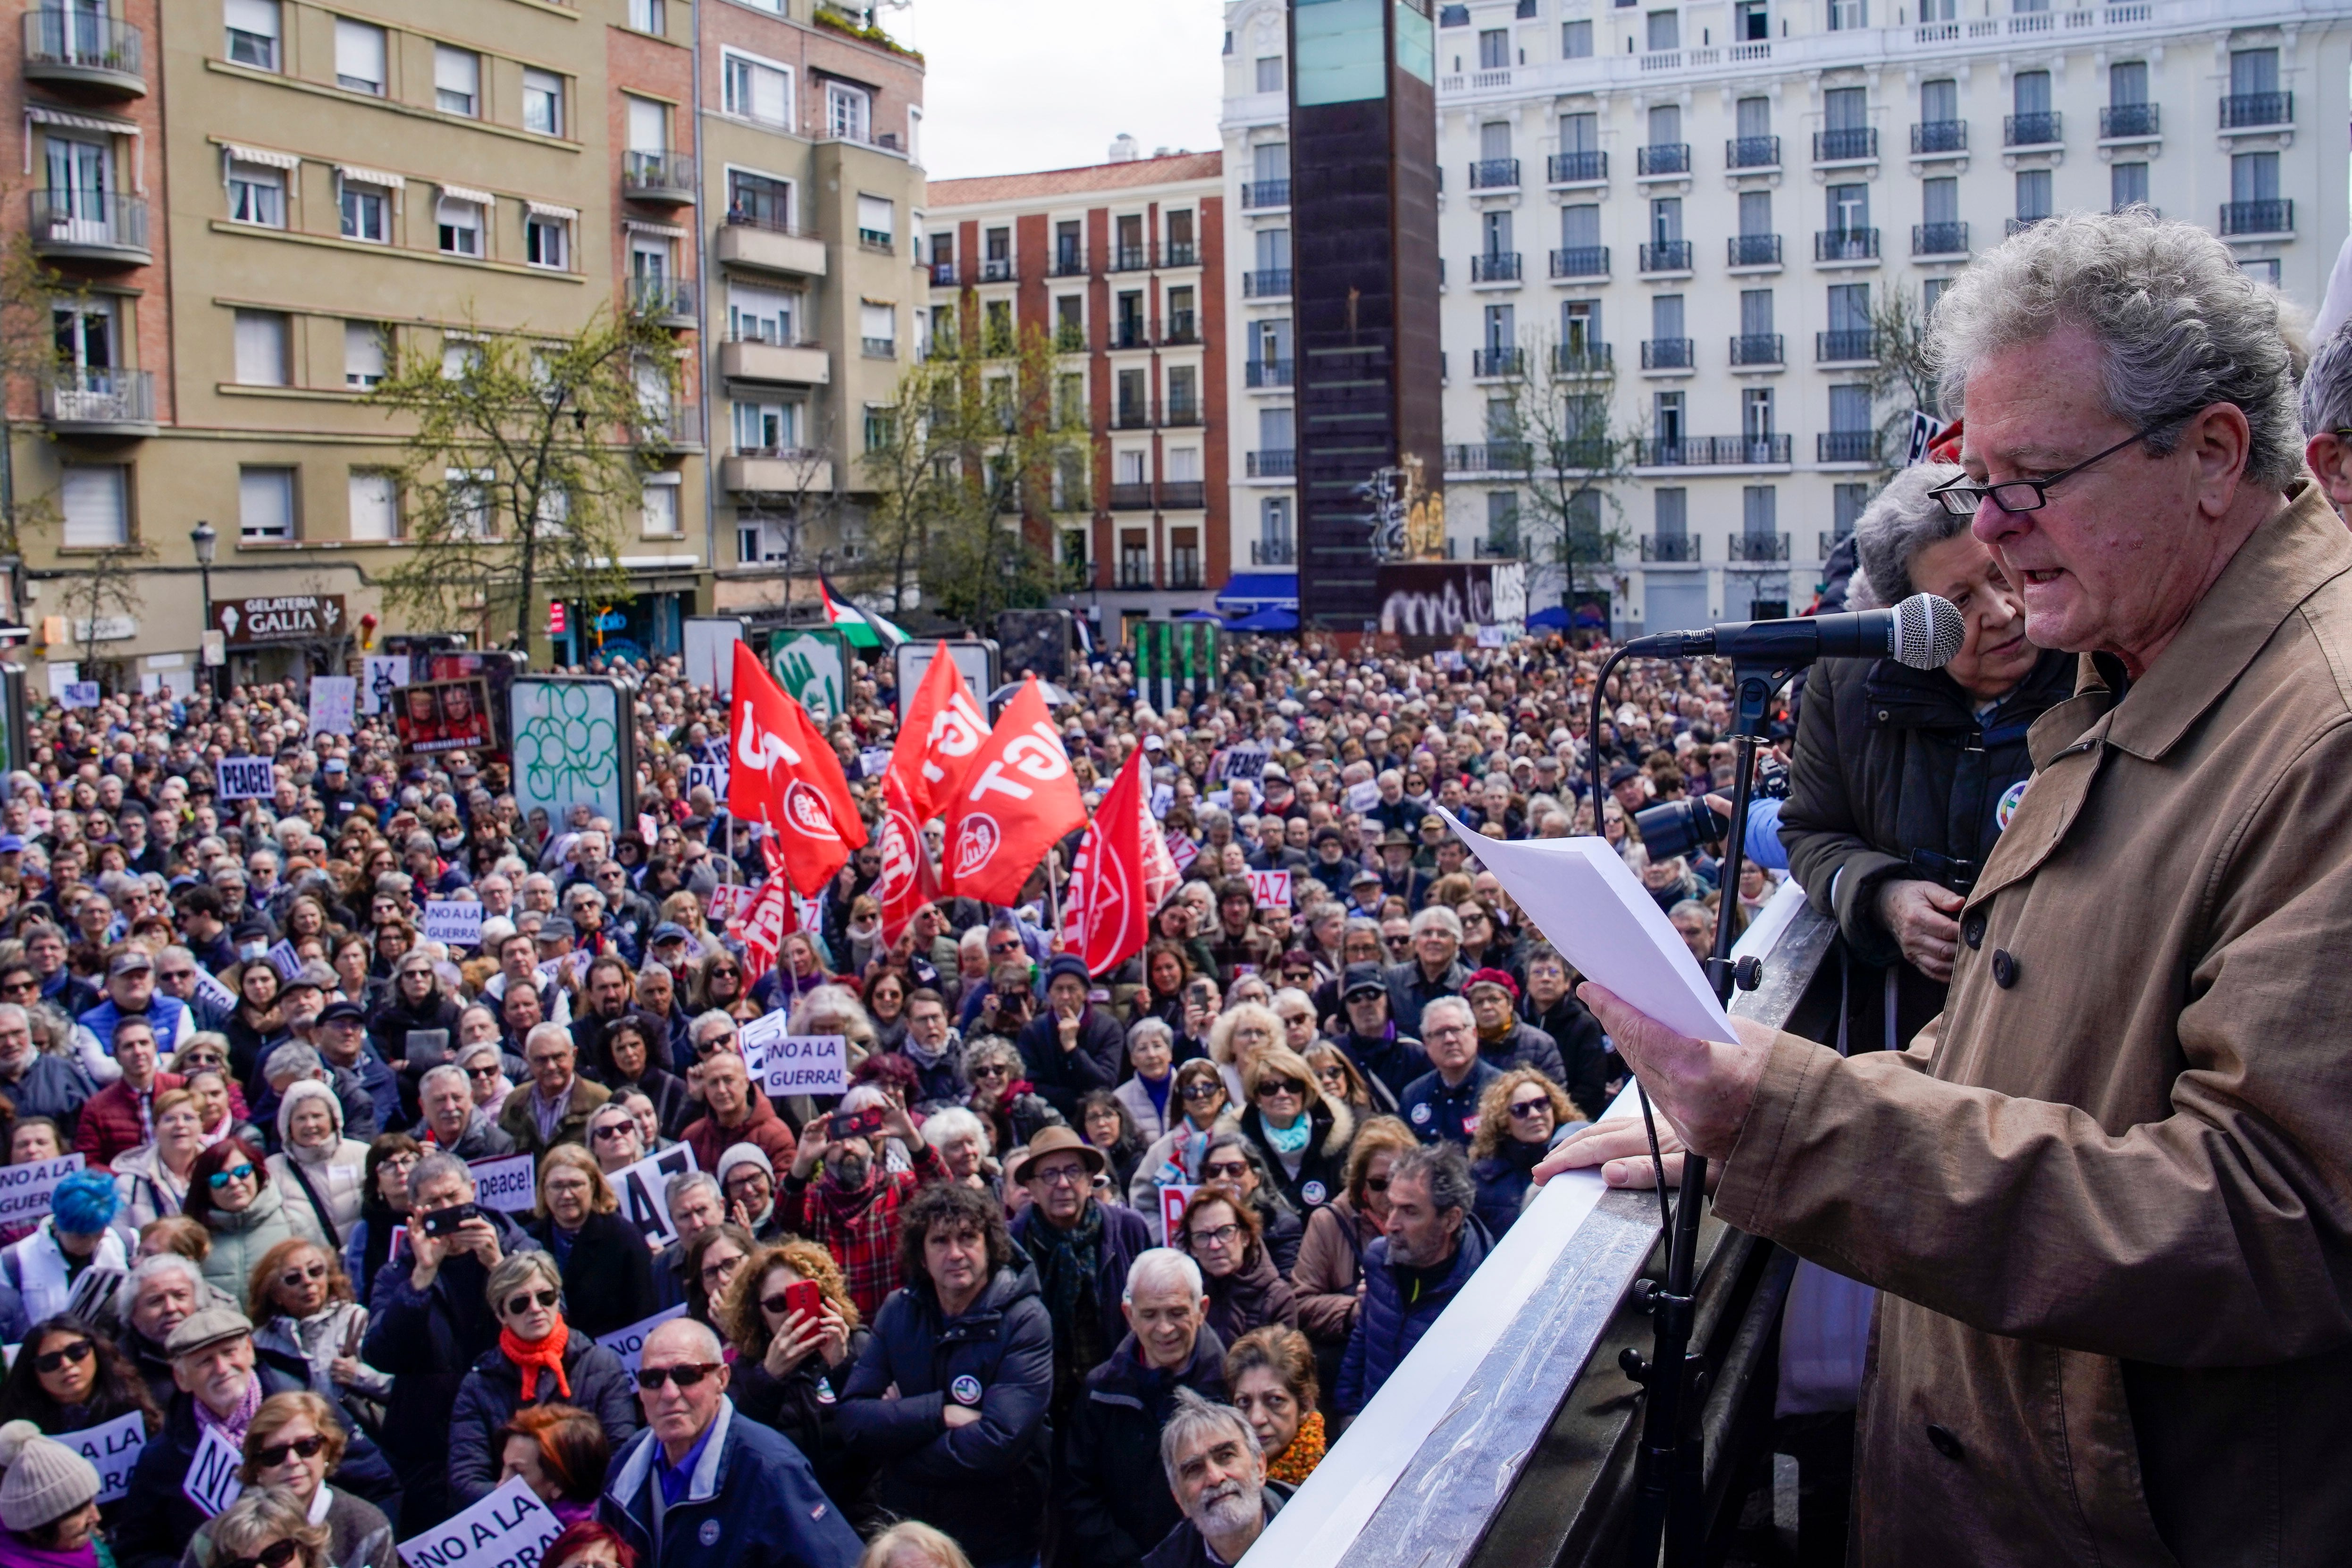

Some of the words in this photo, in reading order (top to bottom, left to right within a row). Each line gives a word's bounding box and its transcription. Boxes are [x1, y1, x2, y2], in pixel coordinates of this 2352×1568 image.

[222, 764, 272, 795] PEACE!
[453, 908, 461, 919] A
[464, 908, 479, 919] LA
[766, 1043, 797, 1063] ¡NO
[801, 1042, 813, 1057] A
[817, 1042, 836, 1057] LA
[770, 1069, 841, 1086] GUERRA!
[33, 1166, 48, 1182] A
[52, 1160, 76, 1177] LA
[0, 1191, 52, 1214] GUER
[105, 1427, 141, 1455] LA
[470, 1522, 498, 1549] A
[491, 1494, 541, 1532] LA
